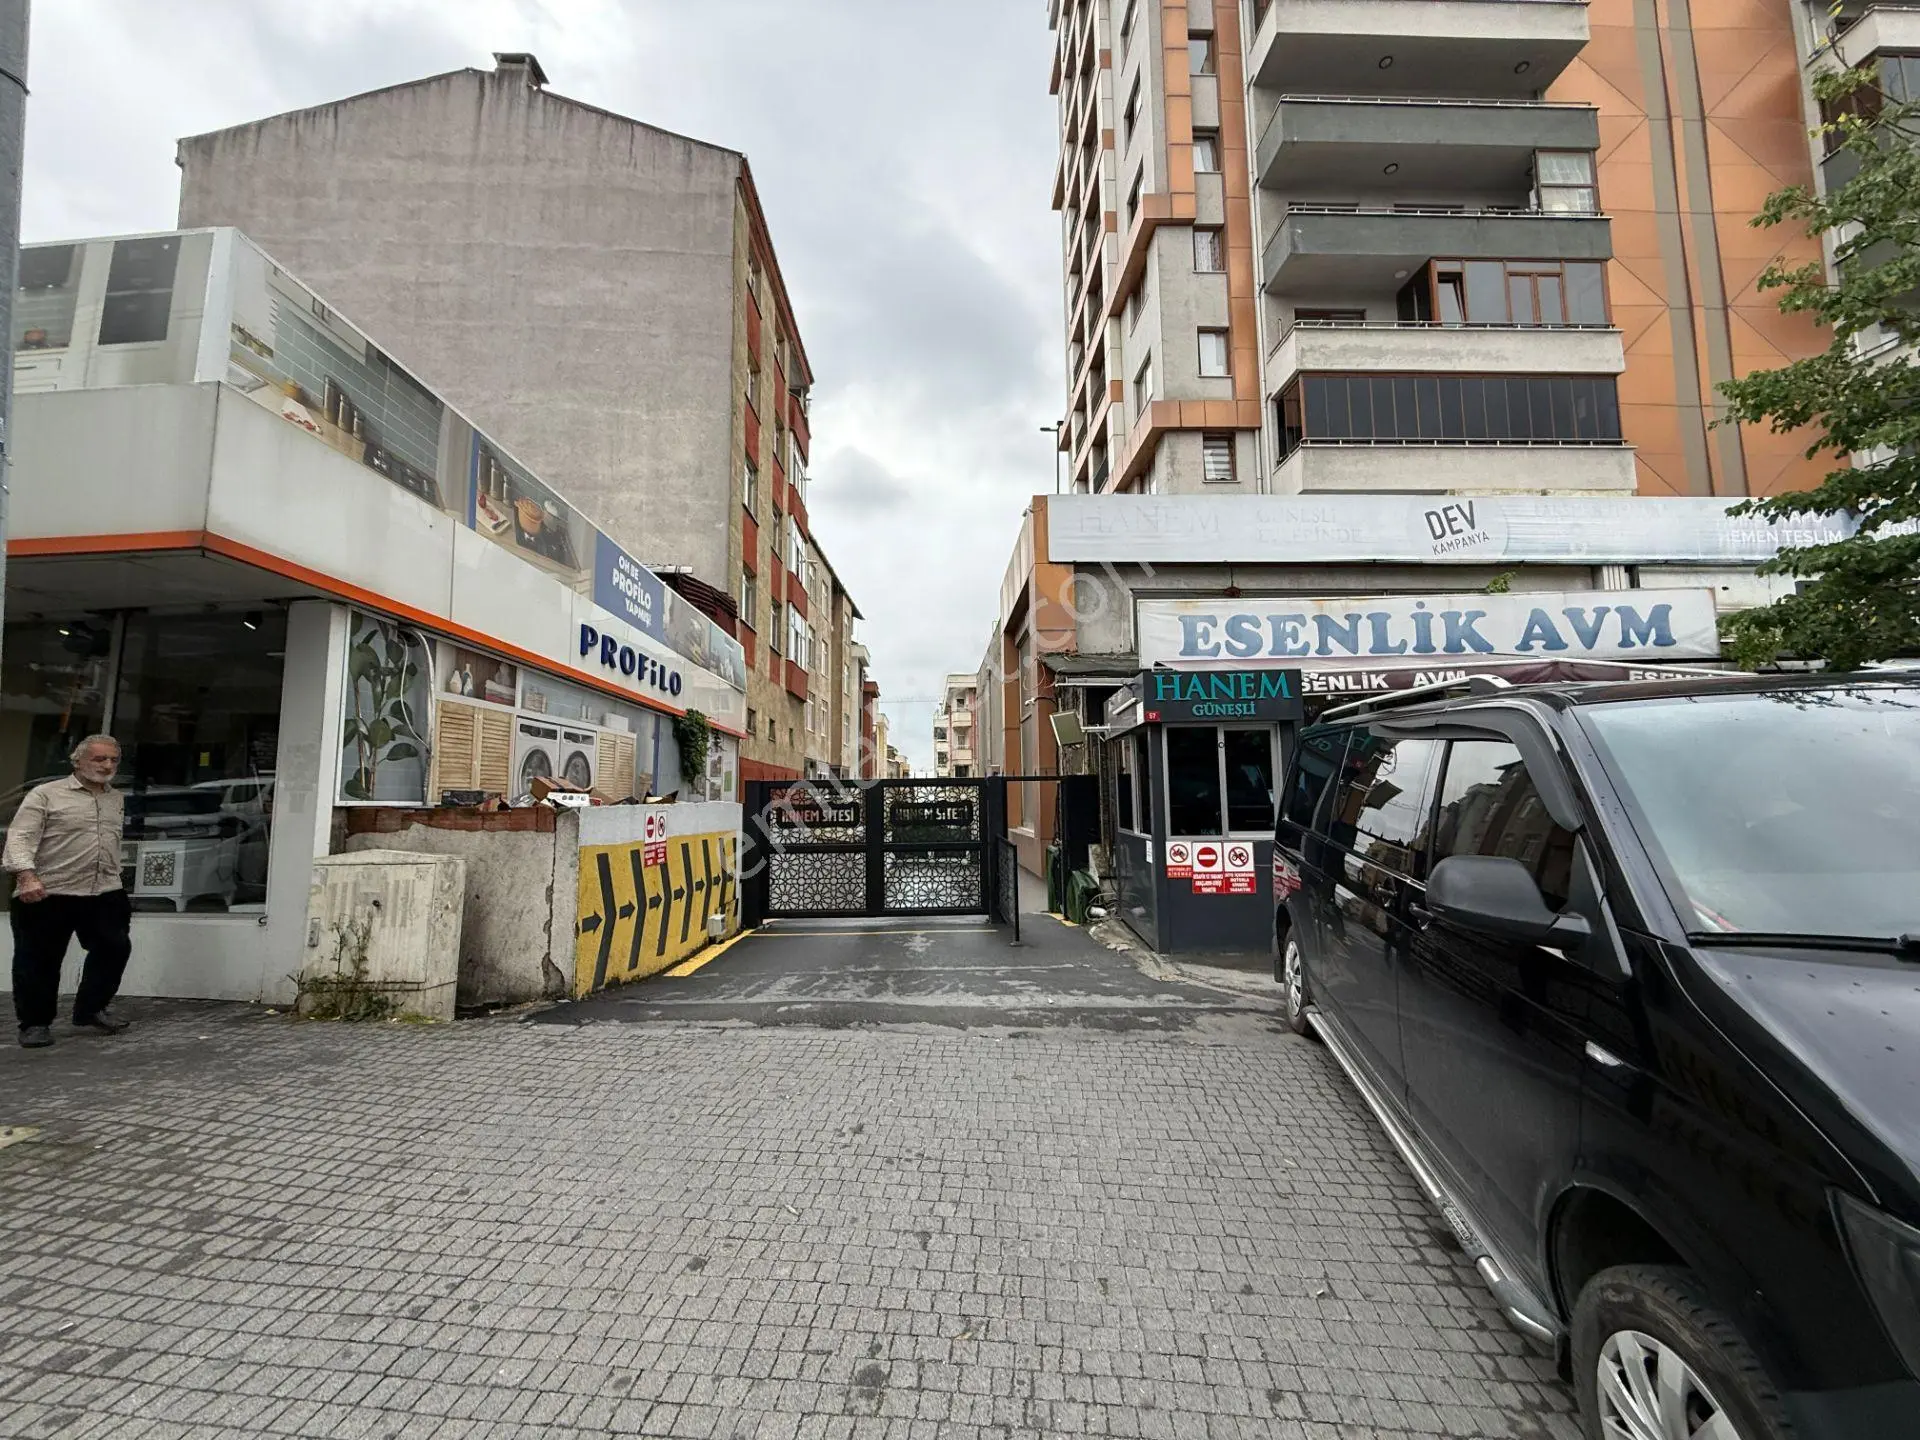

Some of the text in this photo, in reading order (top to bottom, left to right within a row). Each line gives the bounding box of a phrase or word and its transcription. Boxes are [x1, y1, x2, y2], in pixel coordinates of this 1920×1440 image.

[1425, 500, 1475, 540] DEV
[1432, 531, 1490, 555] KAMPANYA
[1782, 527, 1842, 544] TESLİM
[619, 555, 639, 581] OH BE
[612, 568, 652, 609] PROFİLO
[1177, 600, 1677, 658] ESENLİK AVM
[1154, 671, 1294, 700] HANEM
[1413, 670, 1466, 688] AVM
[1192, 701, 1256, 718] GÜNEŞLİ
[822, 806, 855, 823] SİTESİ
